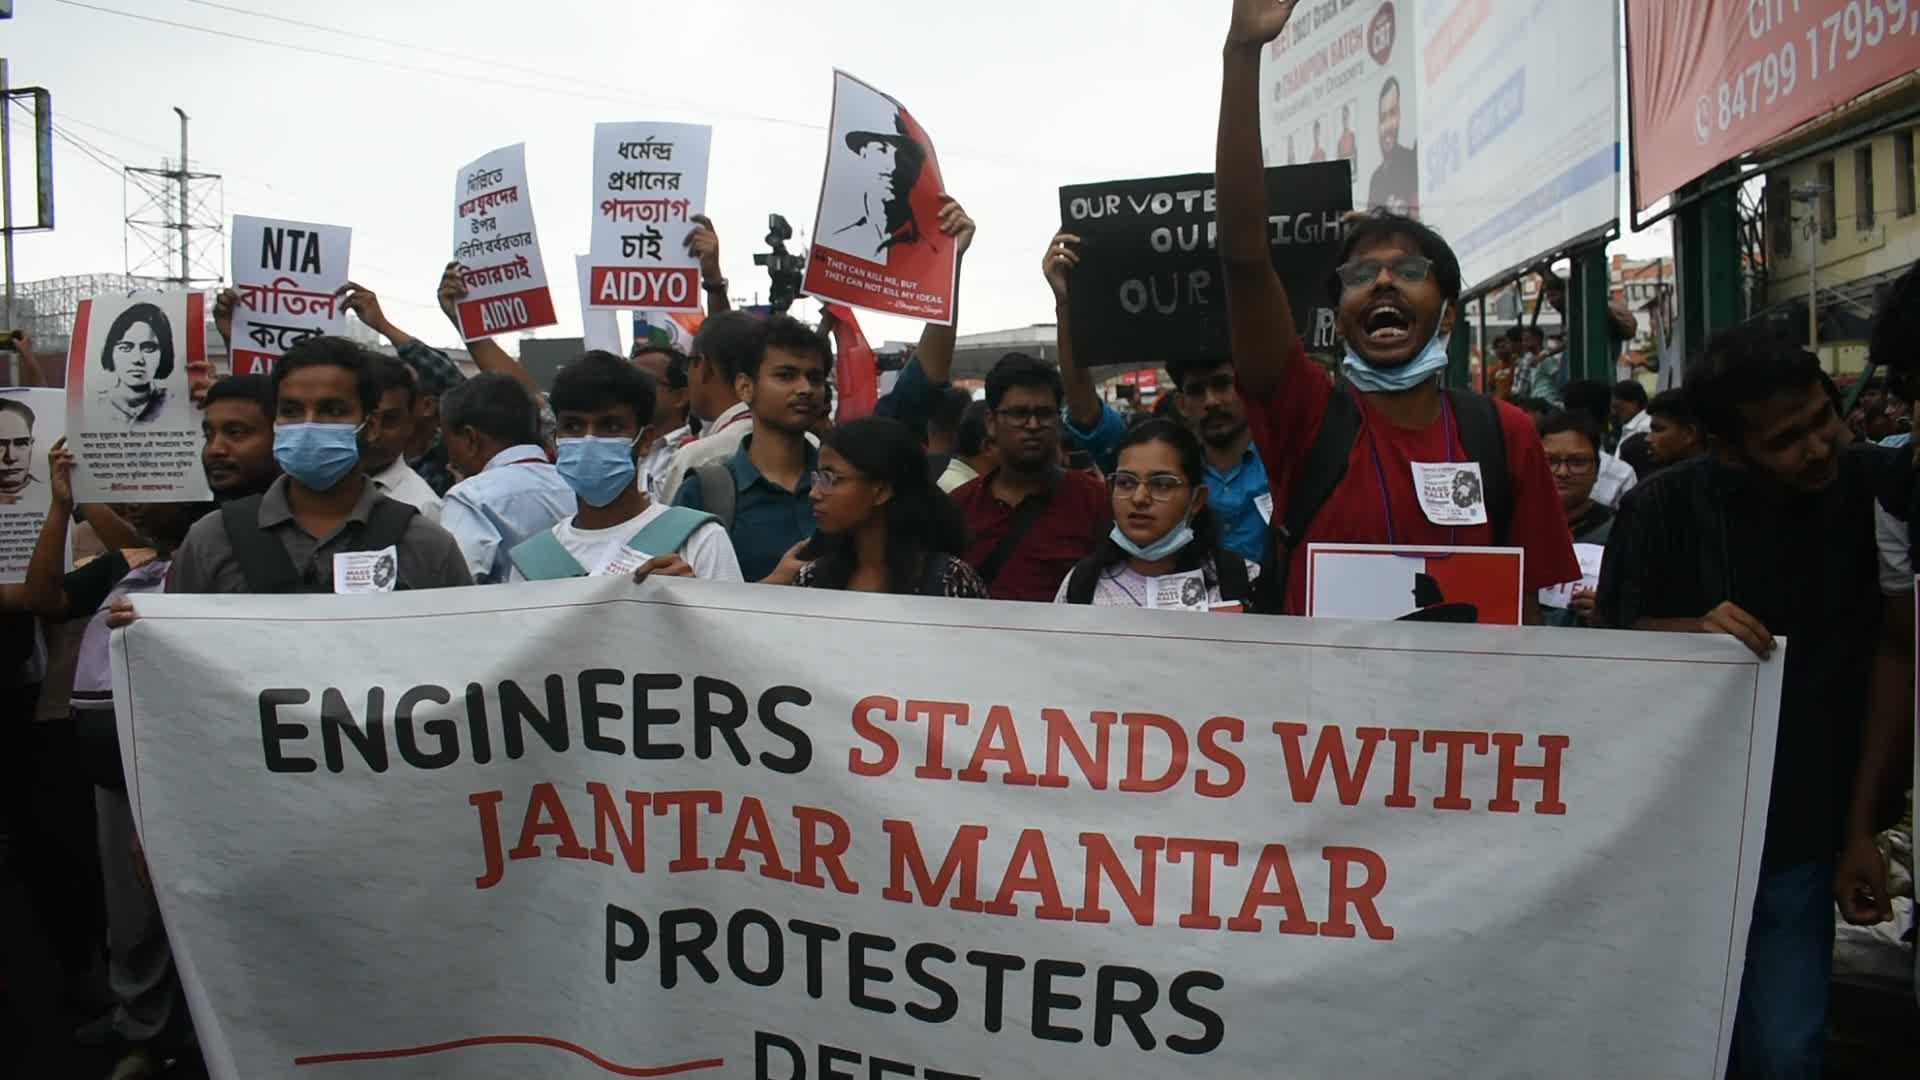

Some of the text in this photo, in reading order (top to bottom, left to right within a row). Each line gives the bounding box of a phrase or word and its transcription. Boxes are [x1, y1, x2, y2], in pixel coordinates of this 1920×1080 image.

[1718, 41, 1796, 131] 84799
[618, 136, 674, 161] ধর্মেন্দ্র
[608, 170, 682, 192] প্রধানের
[600, 198, 691, 223] পদত্যাগ
[1070, 194, 1121, 220] OUR
[471, 217, 496, 234] উপর
[261, 227, 321, 274] NTA
[621, 225, 663, 261] চাই
[502, 254, 532, 280] চাই
[826, 256, 848, 271] THEY
[848, 266, 866, 278] CAN
[867, 271, 883, 283] KILL
[901, 280, 919, 290] BUT
[238, 277, 337, 320] বাতিল
[600, 271, 687, 303] AIDYO
[824, 270, 845, 283] THEY
[846, 277, 864, 288] CAN
[864, 282, 882, 293] NOT
[883, 287, 900, 298] KILL
[901, 291, 916, 301] MY
[1119, 270, 1211, 314] OUR
[480, 297, 529, 332] AIDYO
[258, 668, 1570, 815] ENGINEERS STANDS WITH
[469, 781, 1395, 941] JANTAR MANTAR
[605, 903, 1226, 1056] PROTESTERS
